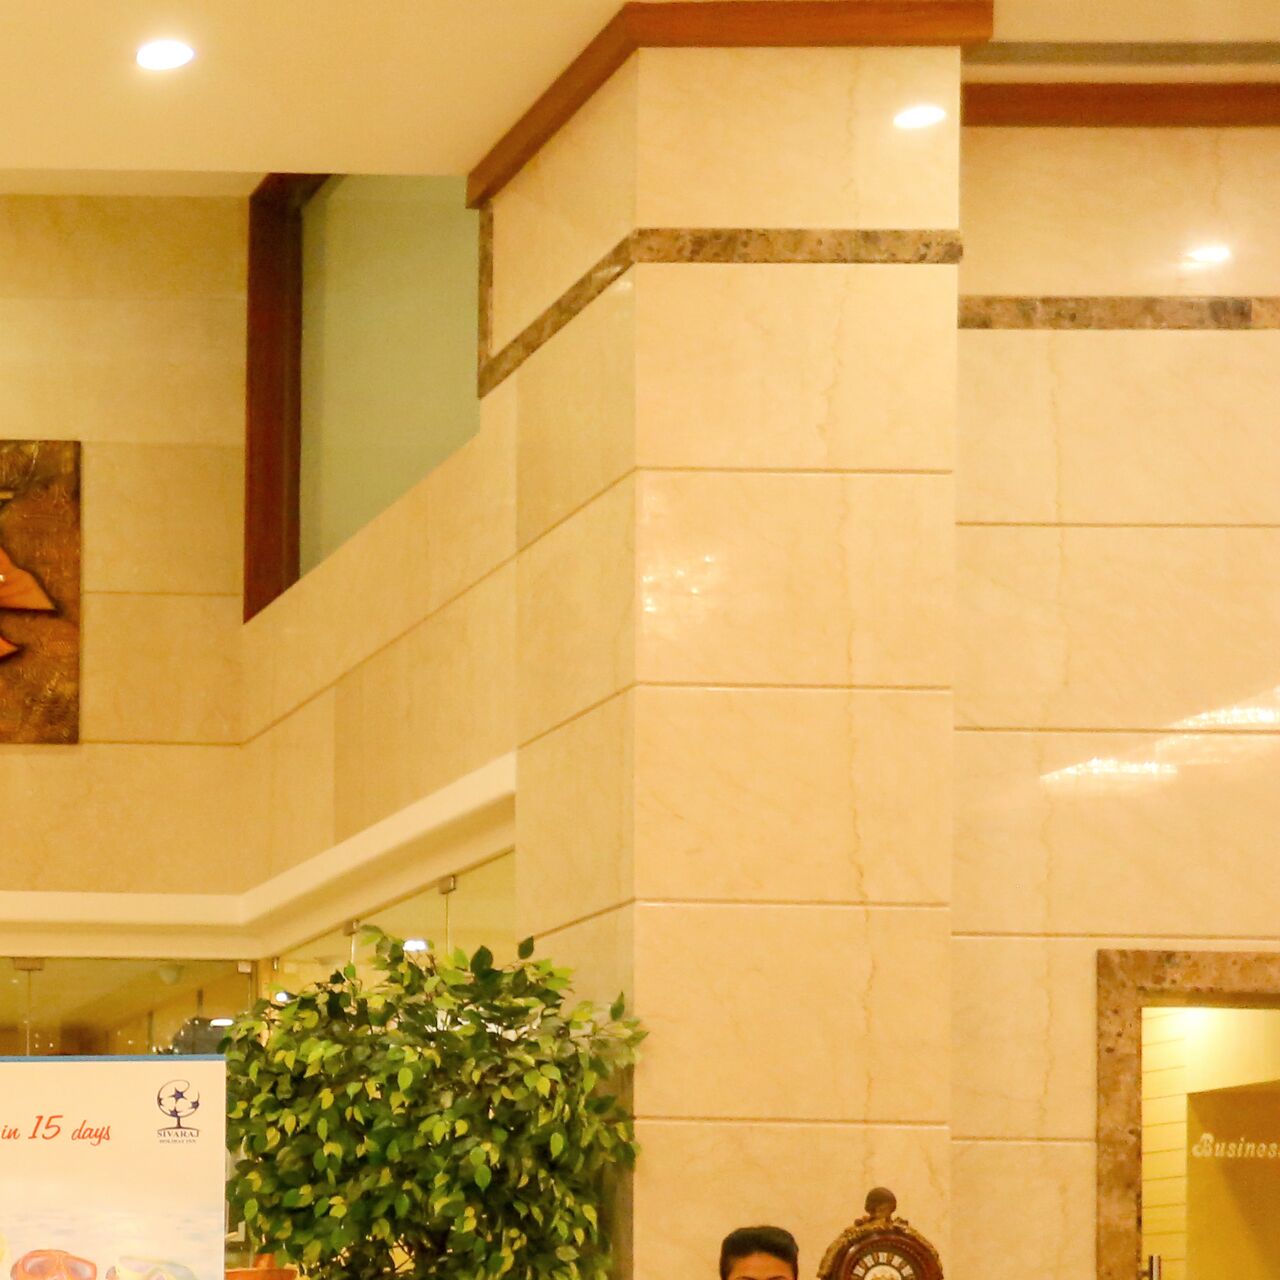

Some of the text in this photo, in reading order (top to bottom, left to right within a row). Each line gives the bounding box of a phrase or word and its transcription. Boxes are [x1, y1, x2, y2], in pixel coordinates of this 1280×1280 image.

[1, 1124, 20, 1141] in
[28, 1115, 63, 1141] 15
[71, 1119, 111, 1147] days
[157, 1129, 200, 1138] SIVARAJ
[1191, 1132, 1280, 1159] Busines
